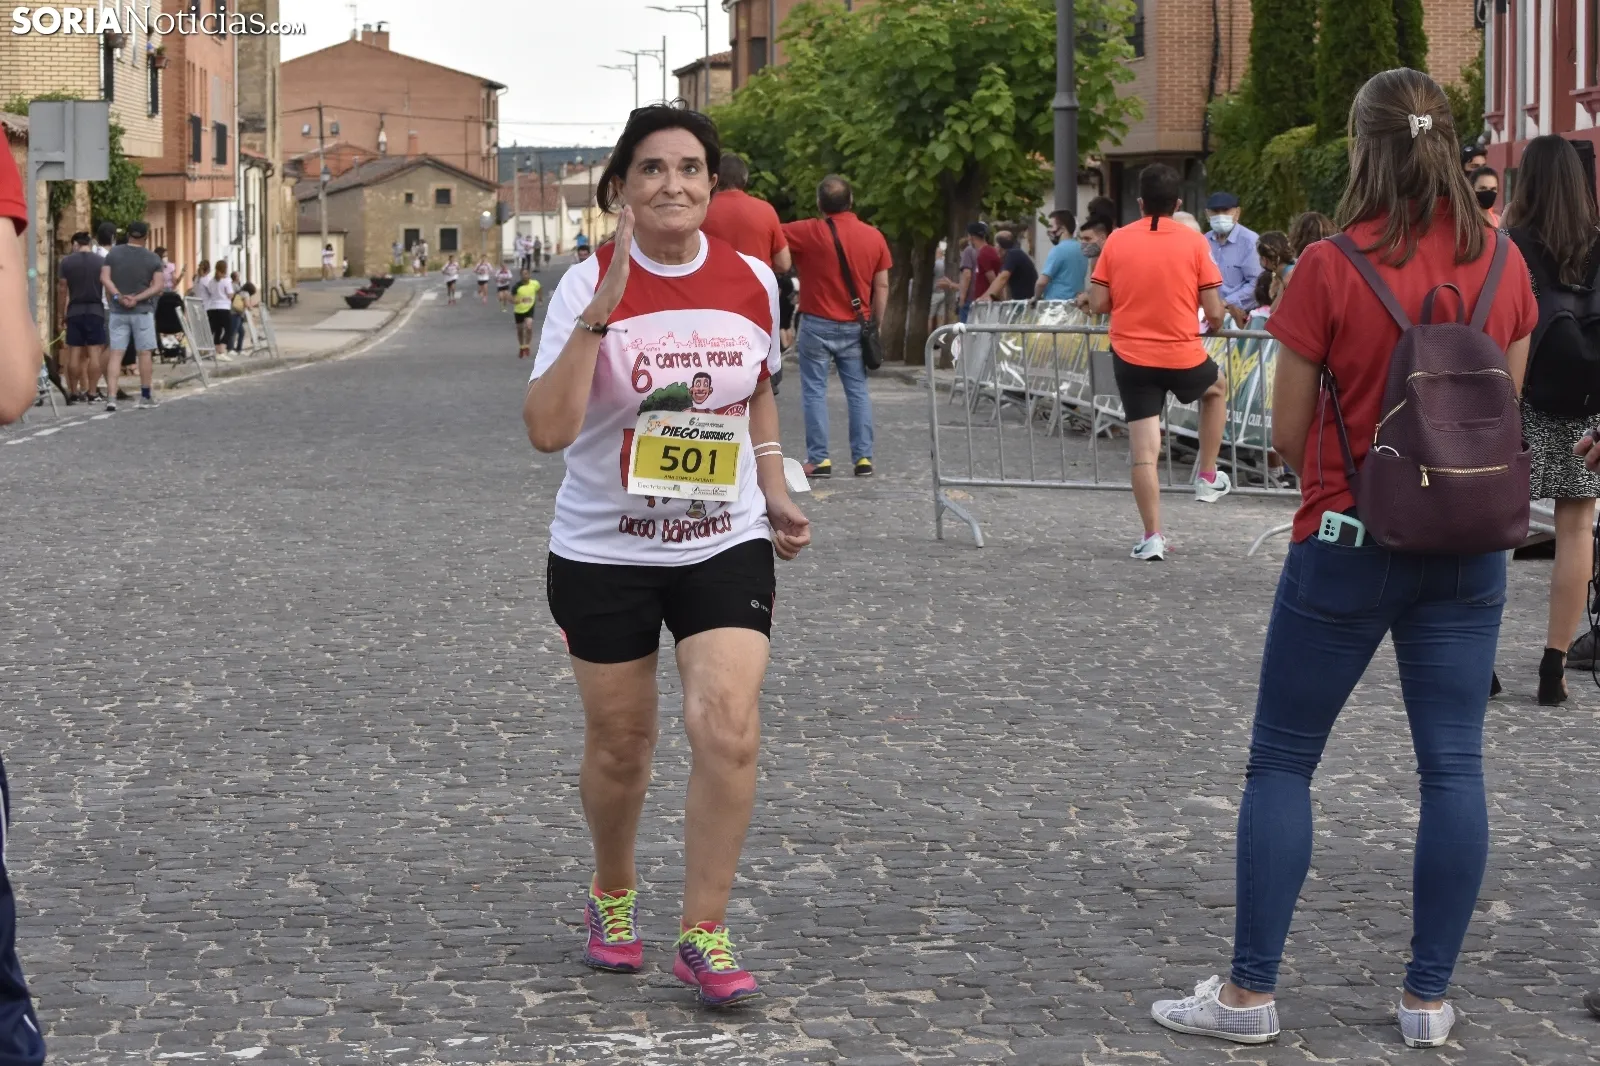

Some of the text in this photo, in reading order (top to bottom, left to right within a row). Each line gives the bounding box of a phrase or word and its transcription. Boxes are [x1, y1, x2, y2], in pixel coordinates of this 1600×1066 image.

[661, 426, 735, 441] DIEGO BARRANCO
[660, 445, 717, 475] 501
[619, 514, 656, 539] DIEGO
